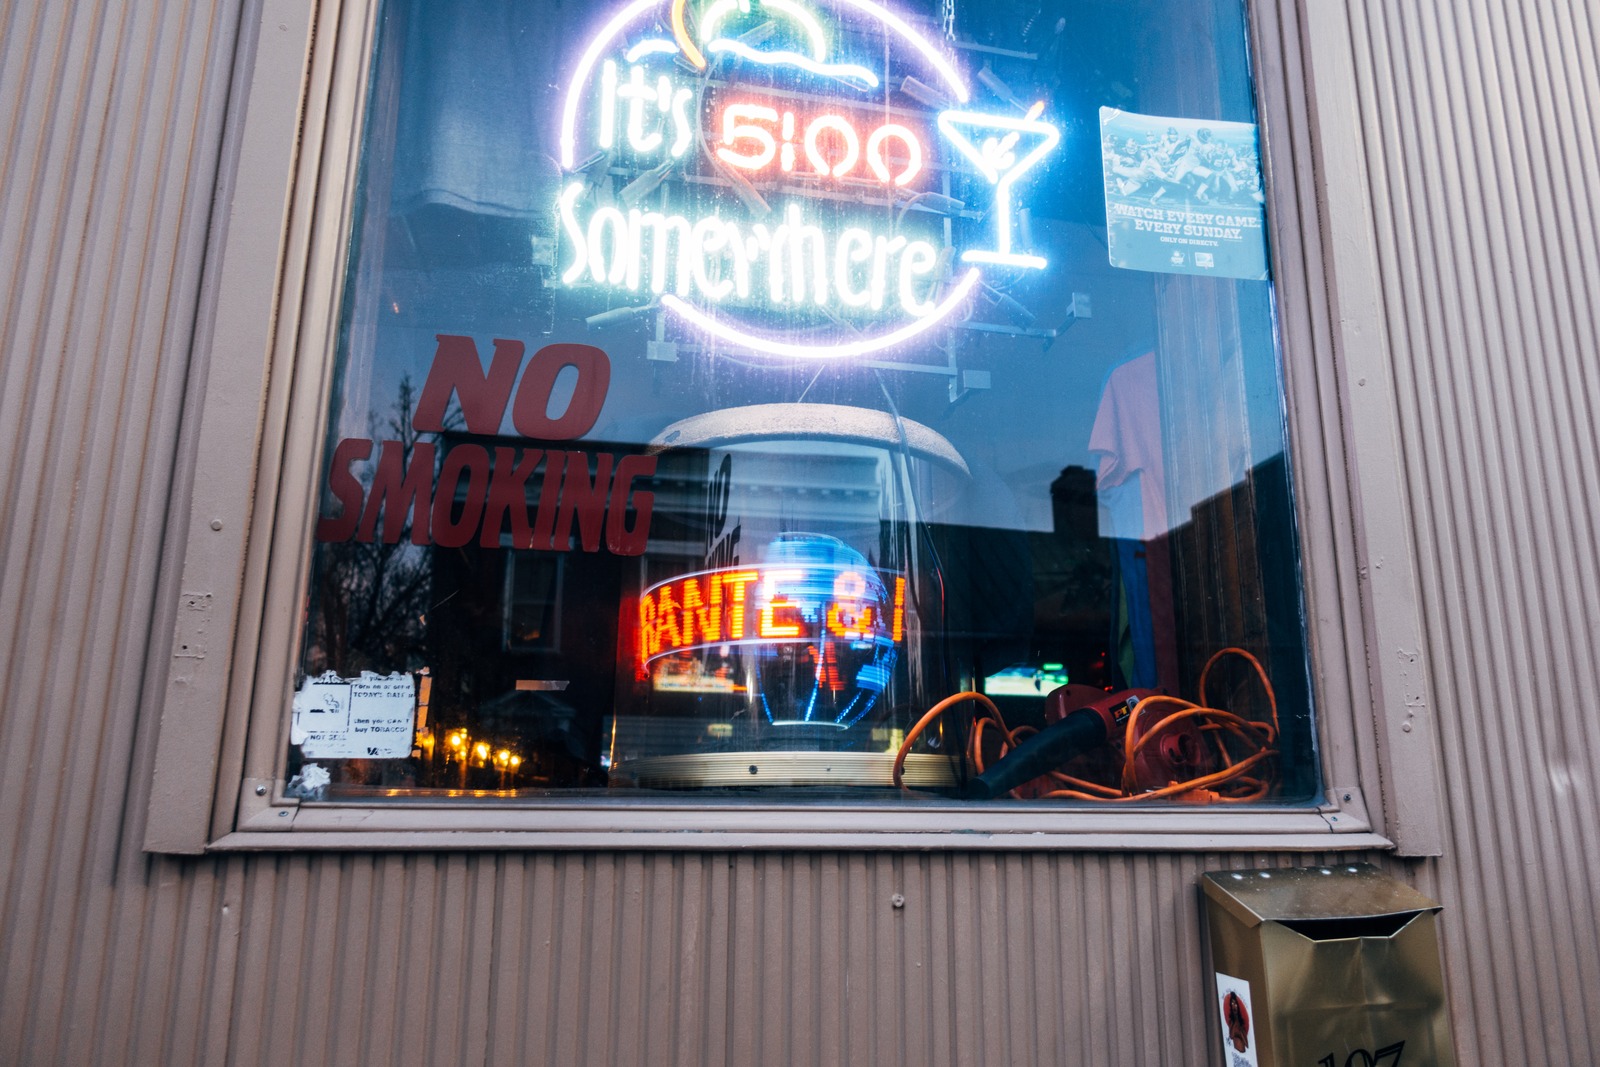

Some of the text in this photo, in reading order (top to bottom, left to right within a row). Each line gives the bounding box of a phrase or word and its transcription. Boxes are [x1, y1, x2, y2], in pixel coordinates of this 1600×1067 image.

[598, 59, 922, 186] It's 5:00
[559, 181, 937, 317] Somewhere
[1114, 204, 1163, 220] WATCH
[1167, 209, 1216, 225] EVERY
[1135, 219, 1243, 240] EVERY SUNDAY.
[1160, 236, 1178, 244] ONLY
[1178, 237, 1188, 245] ON
[411, 333, 612, 441] NO
[315, 437, 659, 557] SMOKING
